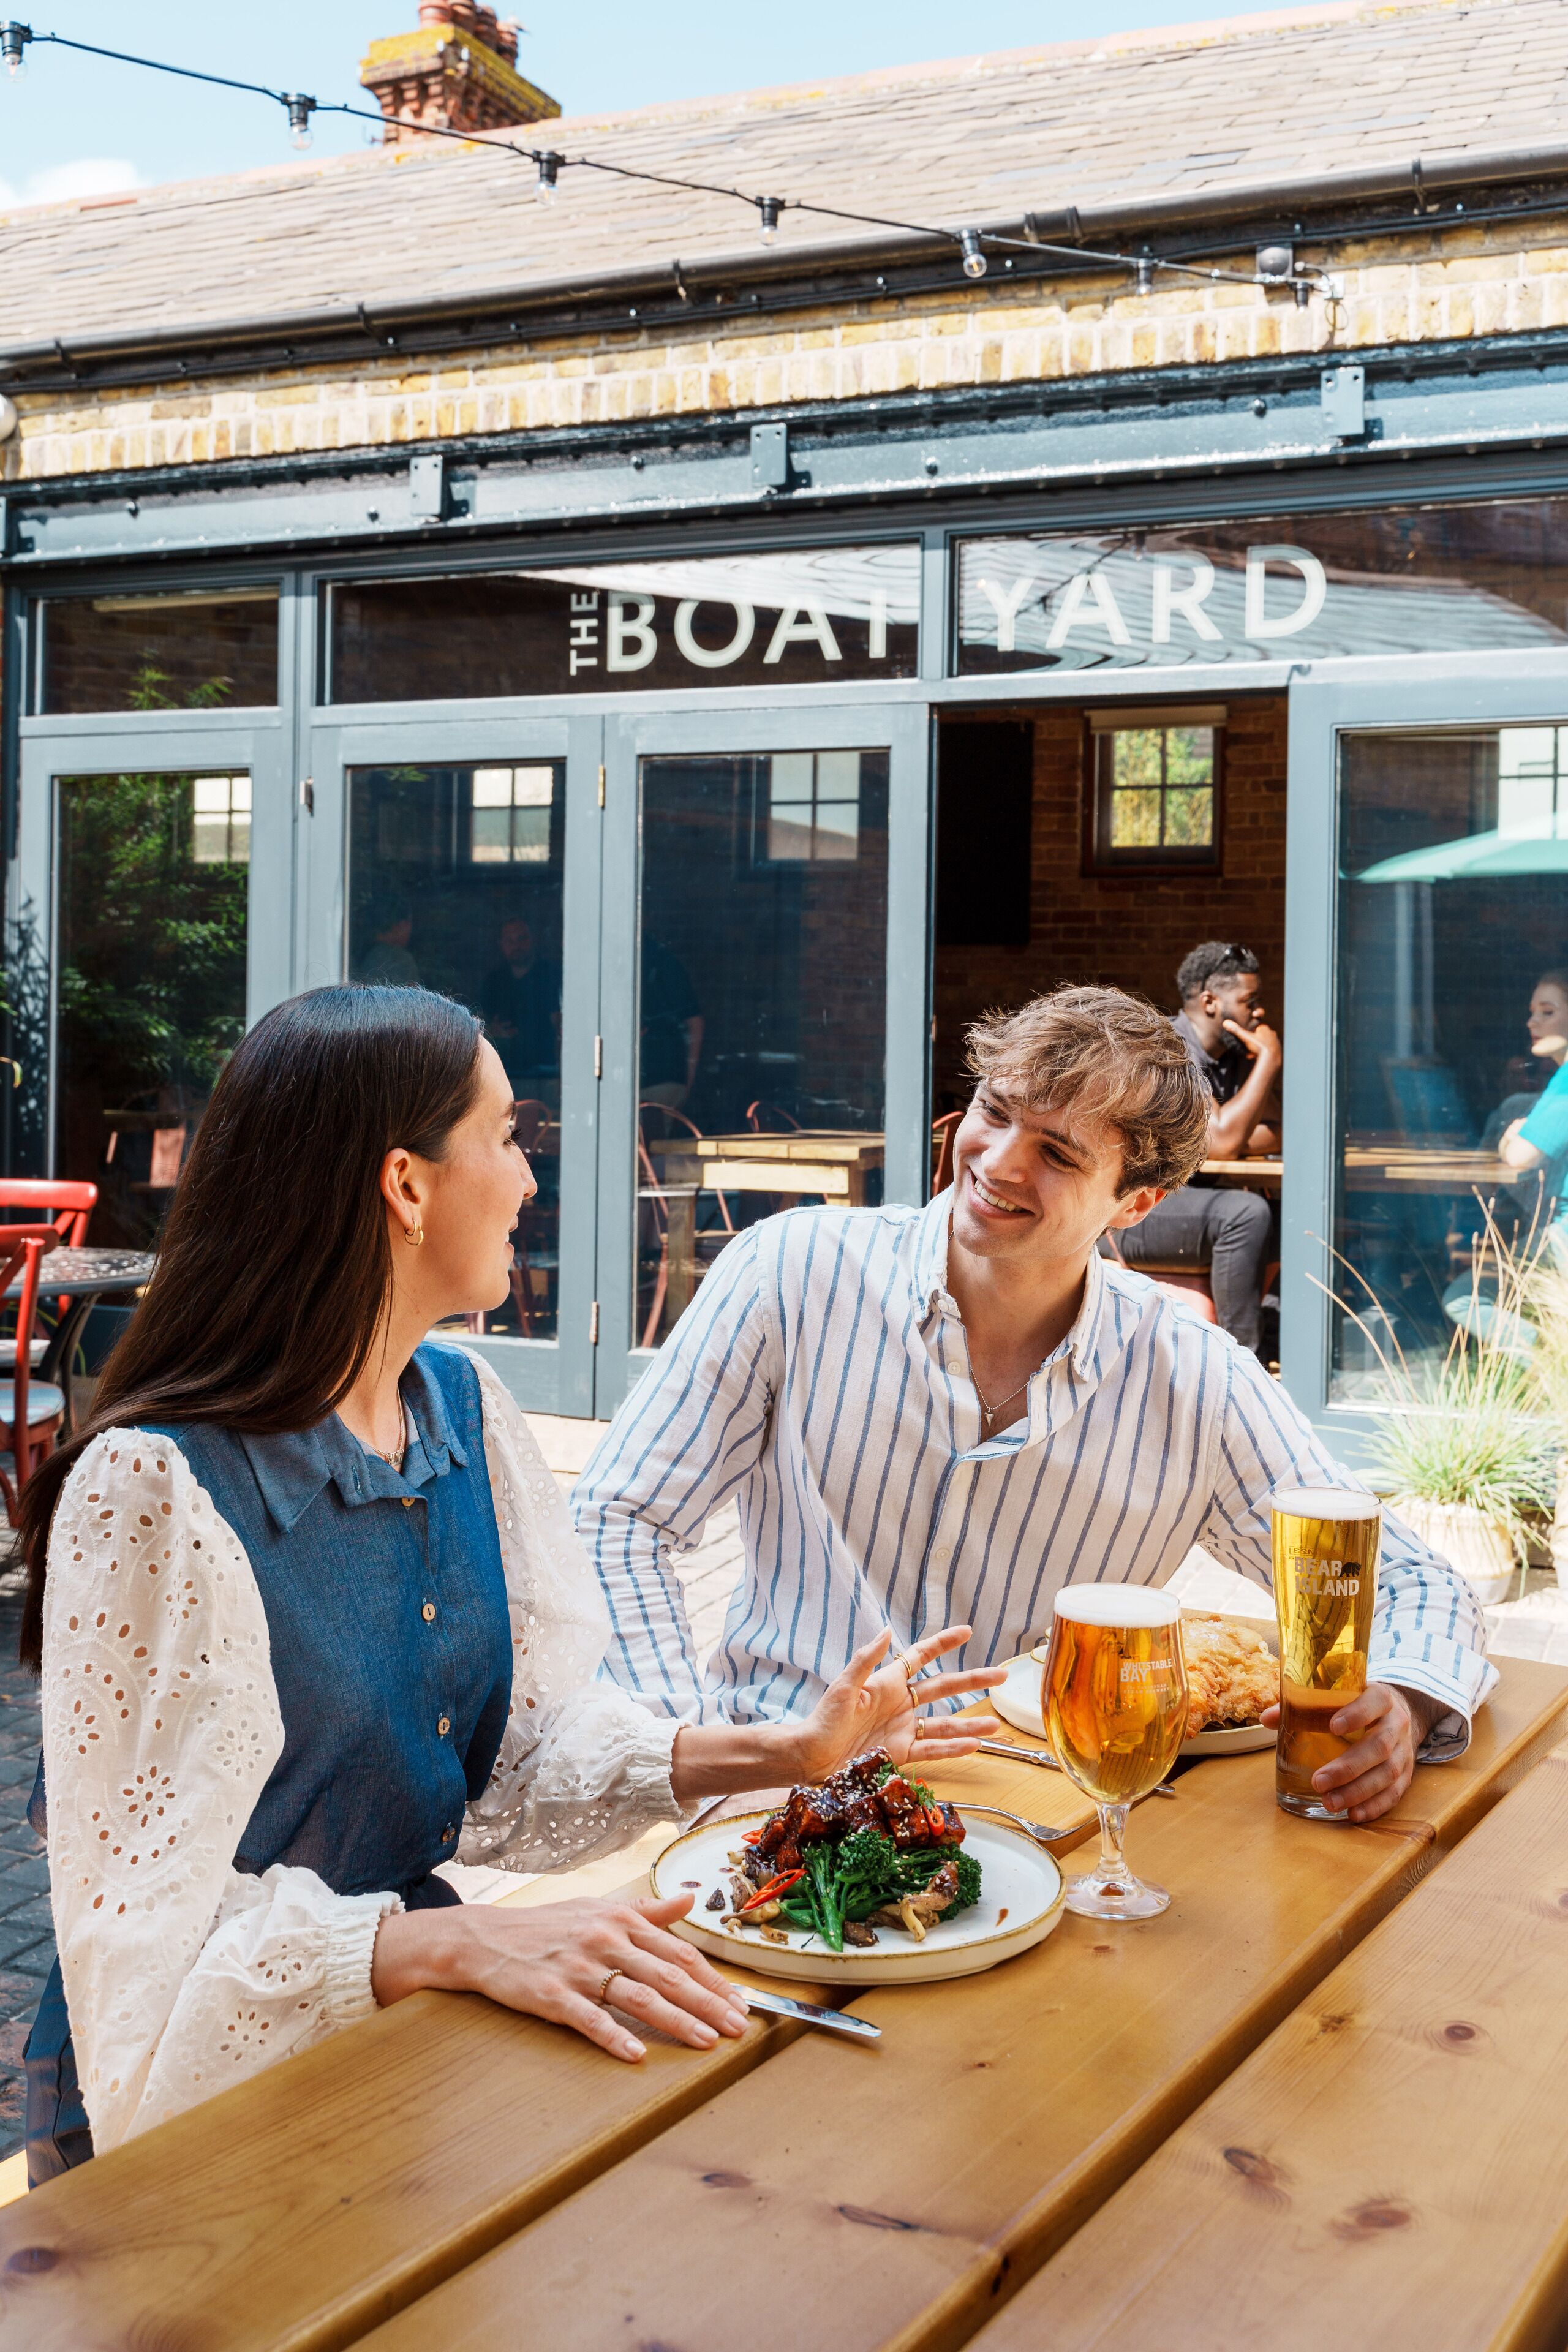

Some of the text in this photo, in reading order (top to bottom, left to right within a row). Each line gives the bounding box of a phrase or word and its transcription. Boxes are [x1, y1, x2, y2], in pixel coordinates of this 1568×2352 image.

[606, 543, 1327, 673] BOAT YARD
[570, 591, 598, 676] THE
[1295, 1556, 1343, 1577] BEAR
[1295, 1575, 1360, 1596] ISLAND
[1120, 1668, 1147, 1683] BAY
[1123, 1659, 1172, 1671] WHITSTABLE
